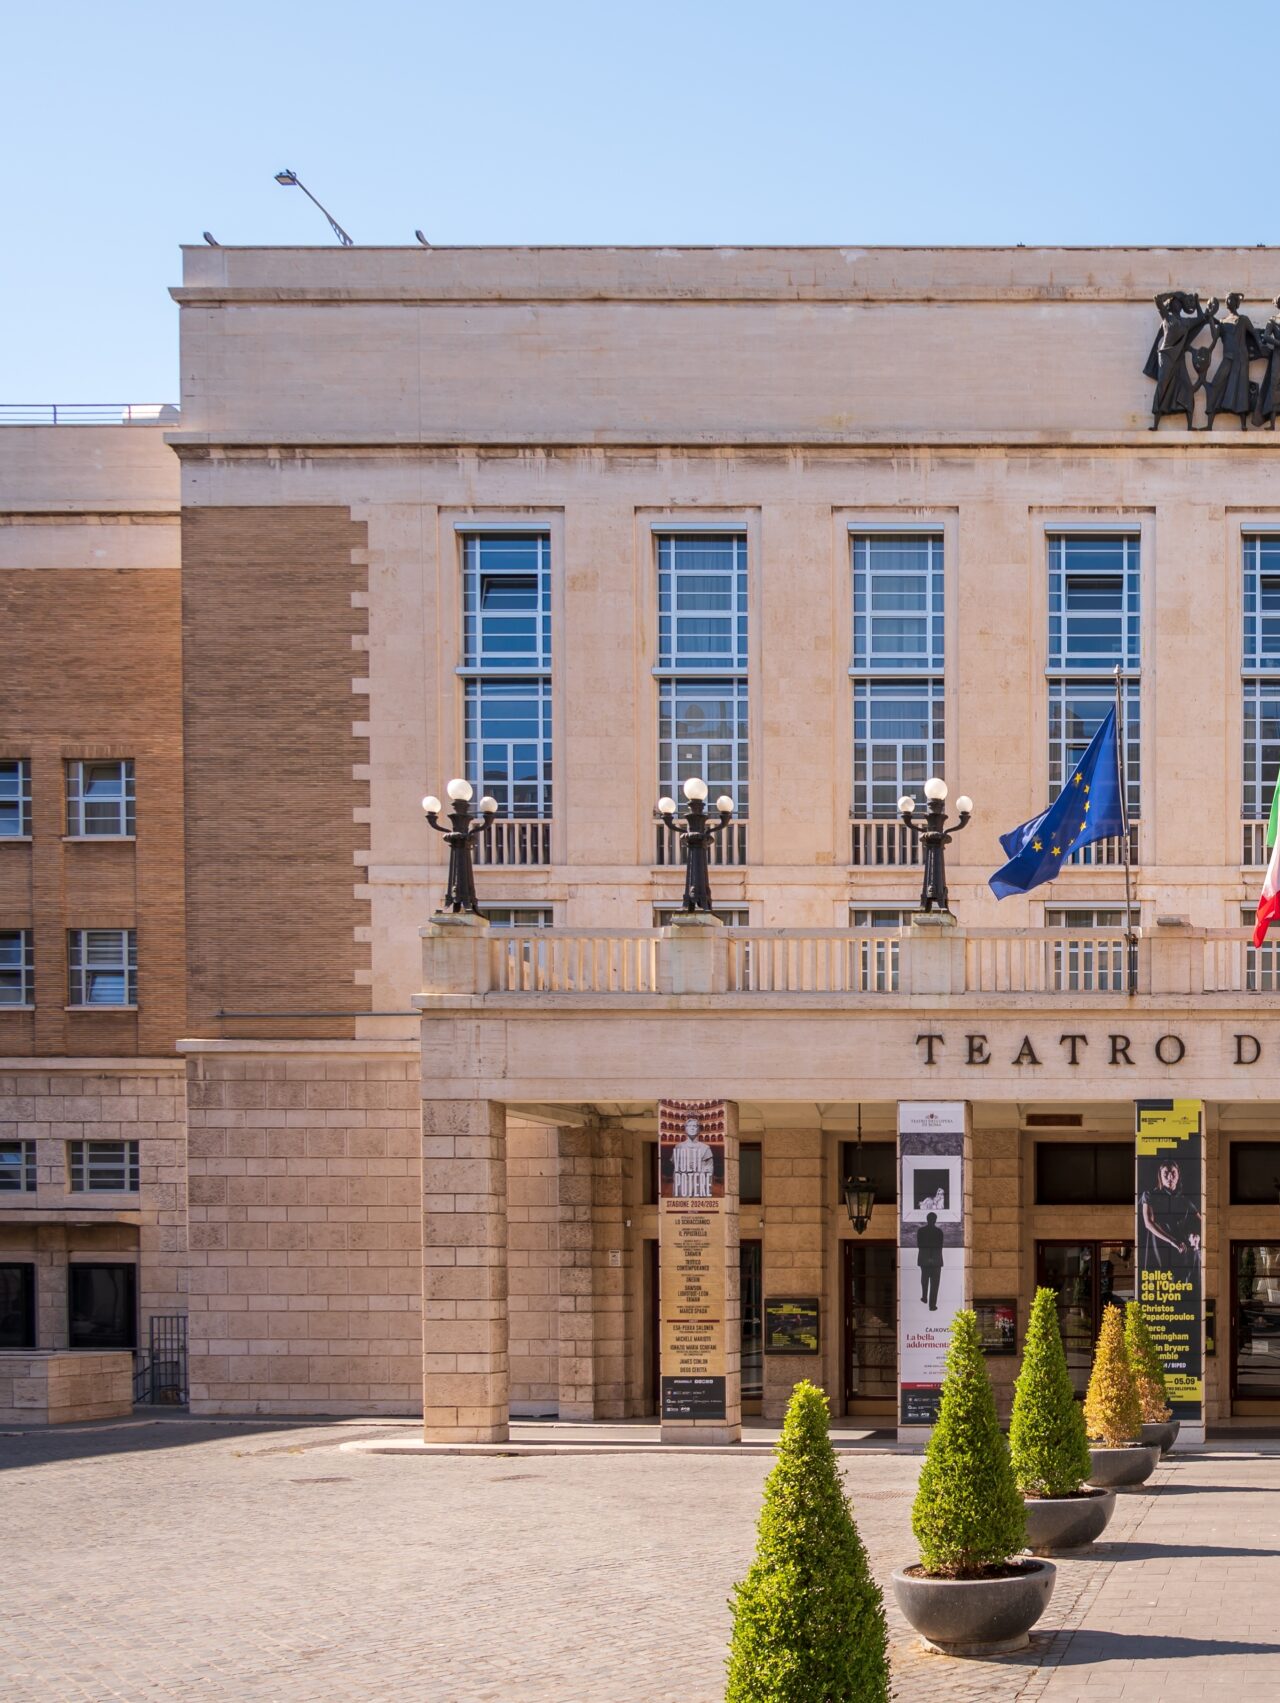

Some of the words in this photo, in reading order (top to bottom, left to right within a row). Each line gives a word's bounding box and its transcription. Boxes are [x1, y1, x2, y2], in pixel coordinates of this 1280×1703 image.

[916, 1034, 1186, 1065] TEATRO
[673, 1148, 702, 1171] VOLTI
[674, 1172, 712, 1197] POTERE
[1142, 1270, 1172, 1280] Ballet
[1142, 1281, 1154, 1290] de
[1157, 1280, 1192, 1292] l'Opéra
[1142, 1291, 1154, 1300] de
[1157, 1291, 1181, 1303] Lyon
[1142, 1304, 1174, 1312] Christos
[1142, 1313, 1195, 1322] Papadopoulos
[1150, 1332, 1189, 1341] nningham
[1164, 1344, 1190, 1352] Bryars
